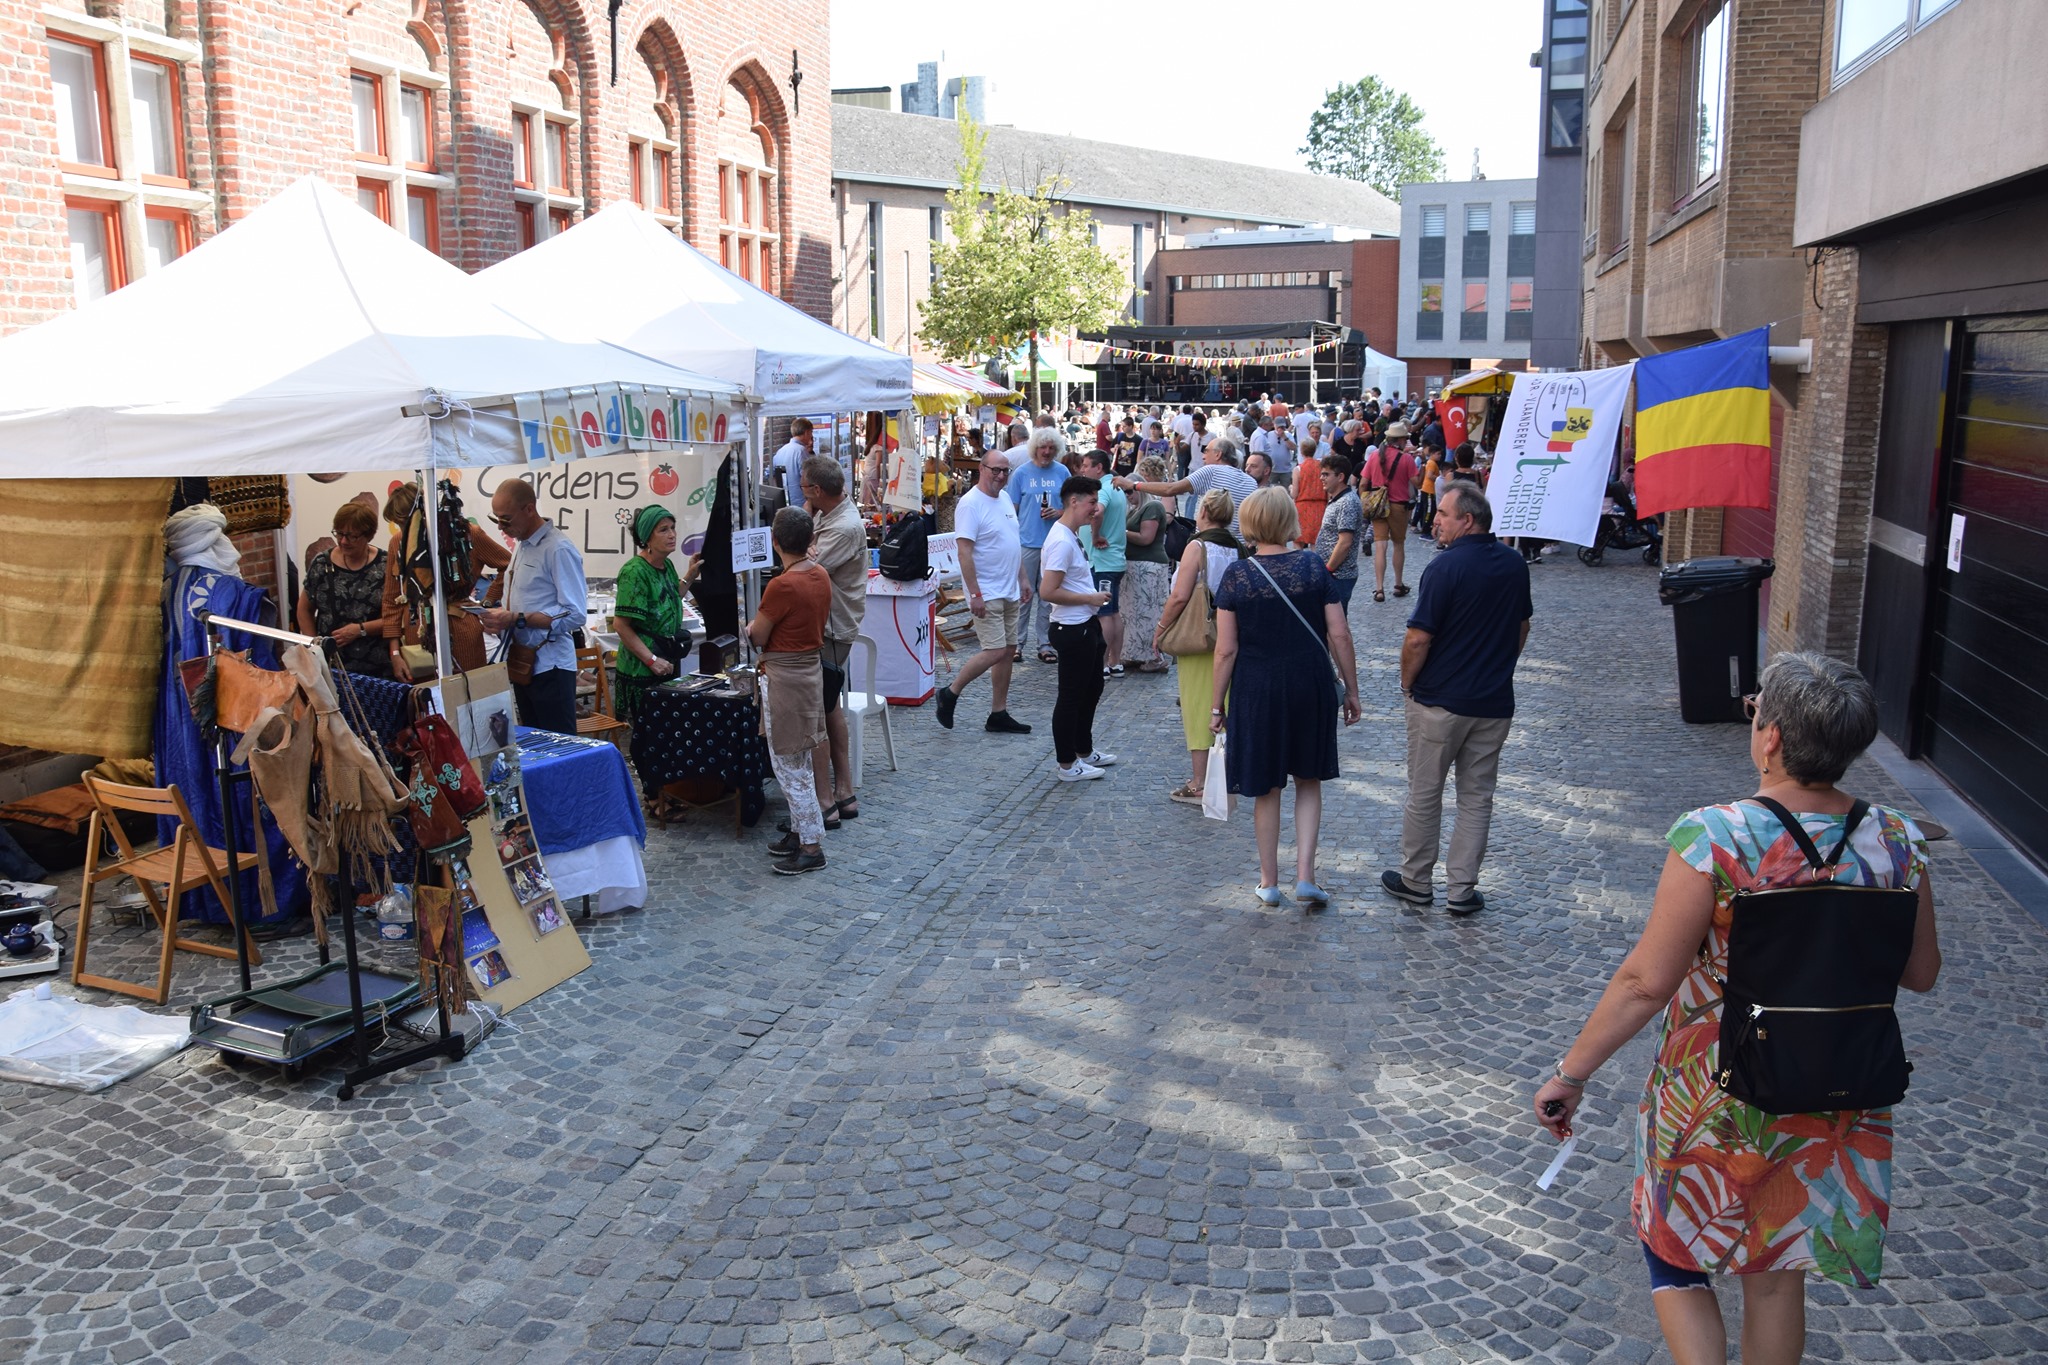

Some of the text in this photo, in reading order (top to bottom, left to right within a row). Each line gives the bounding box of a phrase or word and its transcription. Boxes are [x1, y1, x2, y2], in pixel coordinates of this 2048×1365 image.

[1203, 347, 1237, 358] CASA
[1255, 347, 1303, 359] MUNDO
[523, 394, 727, 461] zaadballen
[1513, 397, 1537, 450] VLAANDEREN
[1030, 477, 1056, 488] ik ben
